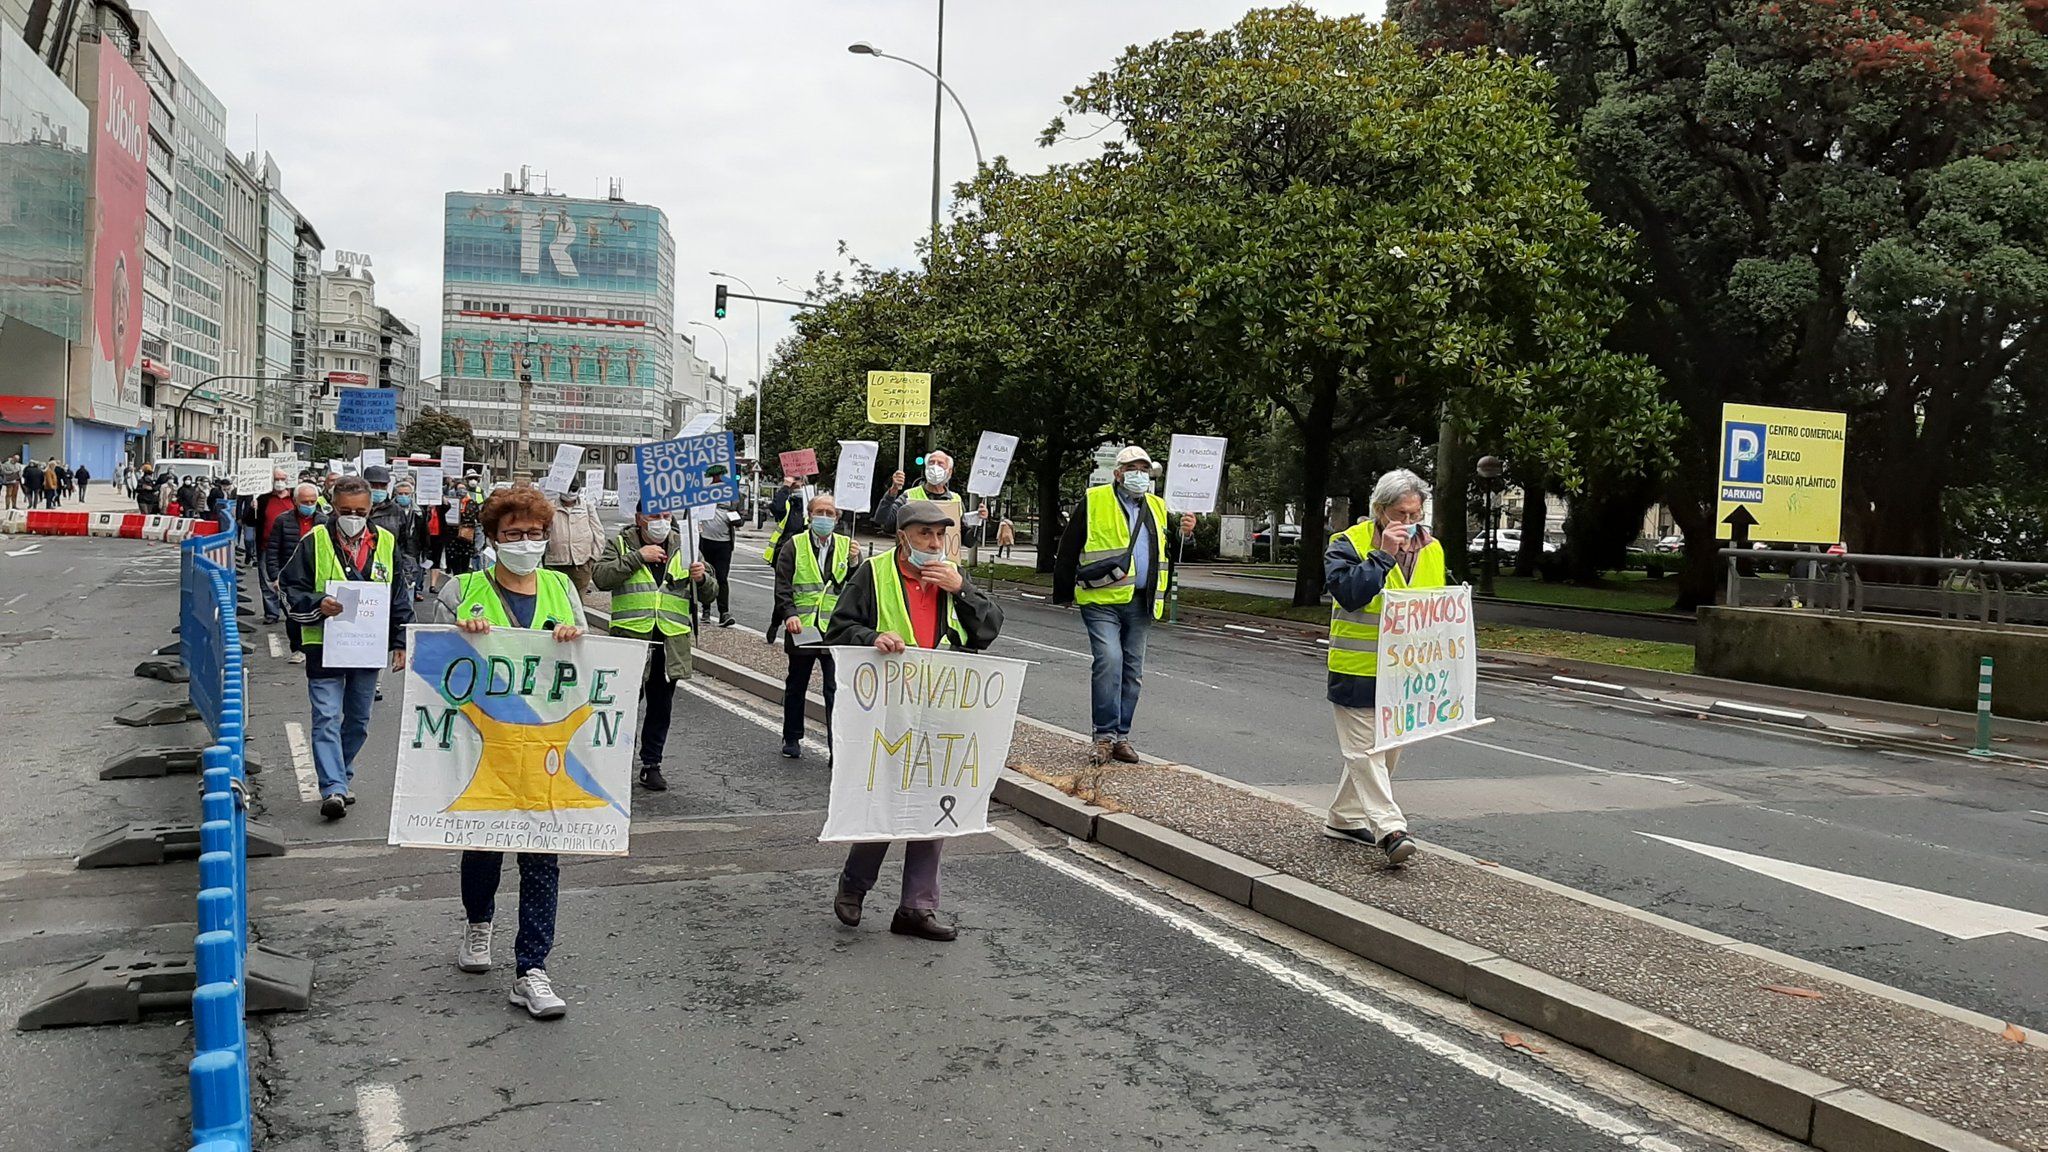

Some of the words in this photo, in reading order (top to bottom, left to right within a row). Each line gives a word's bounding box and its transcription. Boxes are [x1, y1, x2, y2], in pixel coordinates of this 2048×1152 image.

[105, 72, 142, 162] Júbilo
[336, 249, 373, 267] BBVA
[871, 374, 885, 386] LO
[871, 397, 885, 408] LO
[1768, 424, 1799, 437] CENTRO
[1800, 427, 1844, 441] COMERCIAL
[641, 433, 728, 460] SERVIZOS
[1729, 429, 1759, 479] P
[1767, 449, 1801, 462] PALEXCO
[642, 446, 730, 475] SOCIAIS
[644, 469, 700, 498] 100%
[1766, 474, 1794, 487] CASINO
[1795, 474, 1837, 489] ATLÁNTICO
[647, 486, 734, 513] PÚBLICOS
[1722, 488, 1762, 500] PARKING
[1403, 669, 1450, 700] 100%
[866, 727, 980, 791] MATA
[407, 814, 485, 830] MOVEMENTO
[490, 820, 530, 831] GALEGO
[539, 821, 564, 833] POLA
[566, 823, 618, 836] DEFENSA
[444, 830, 473, 846] DAS
